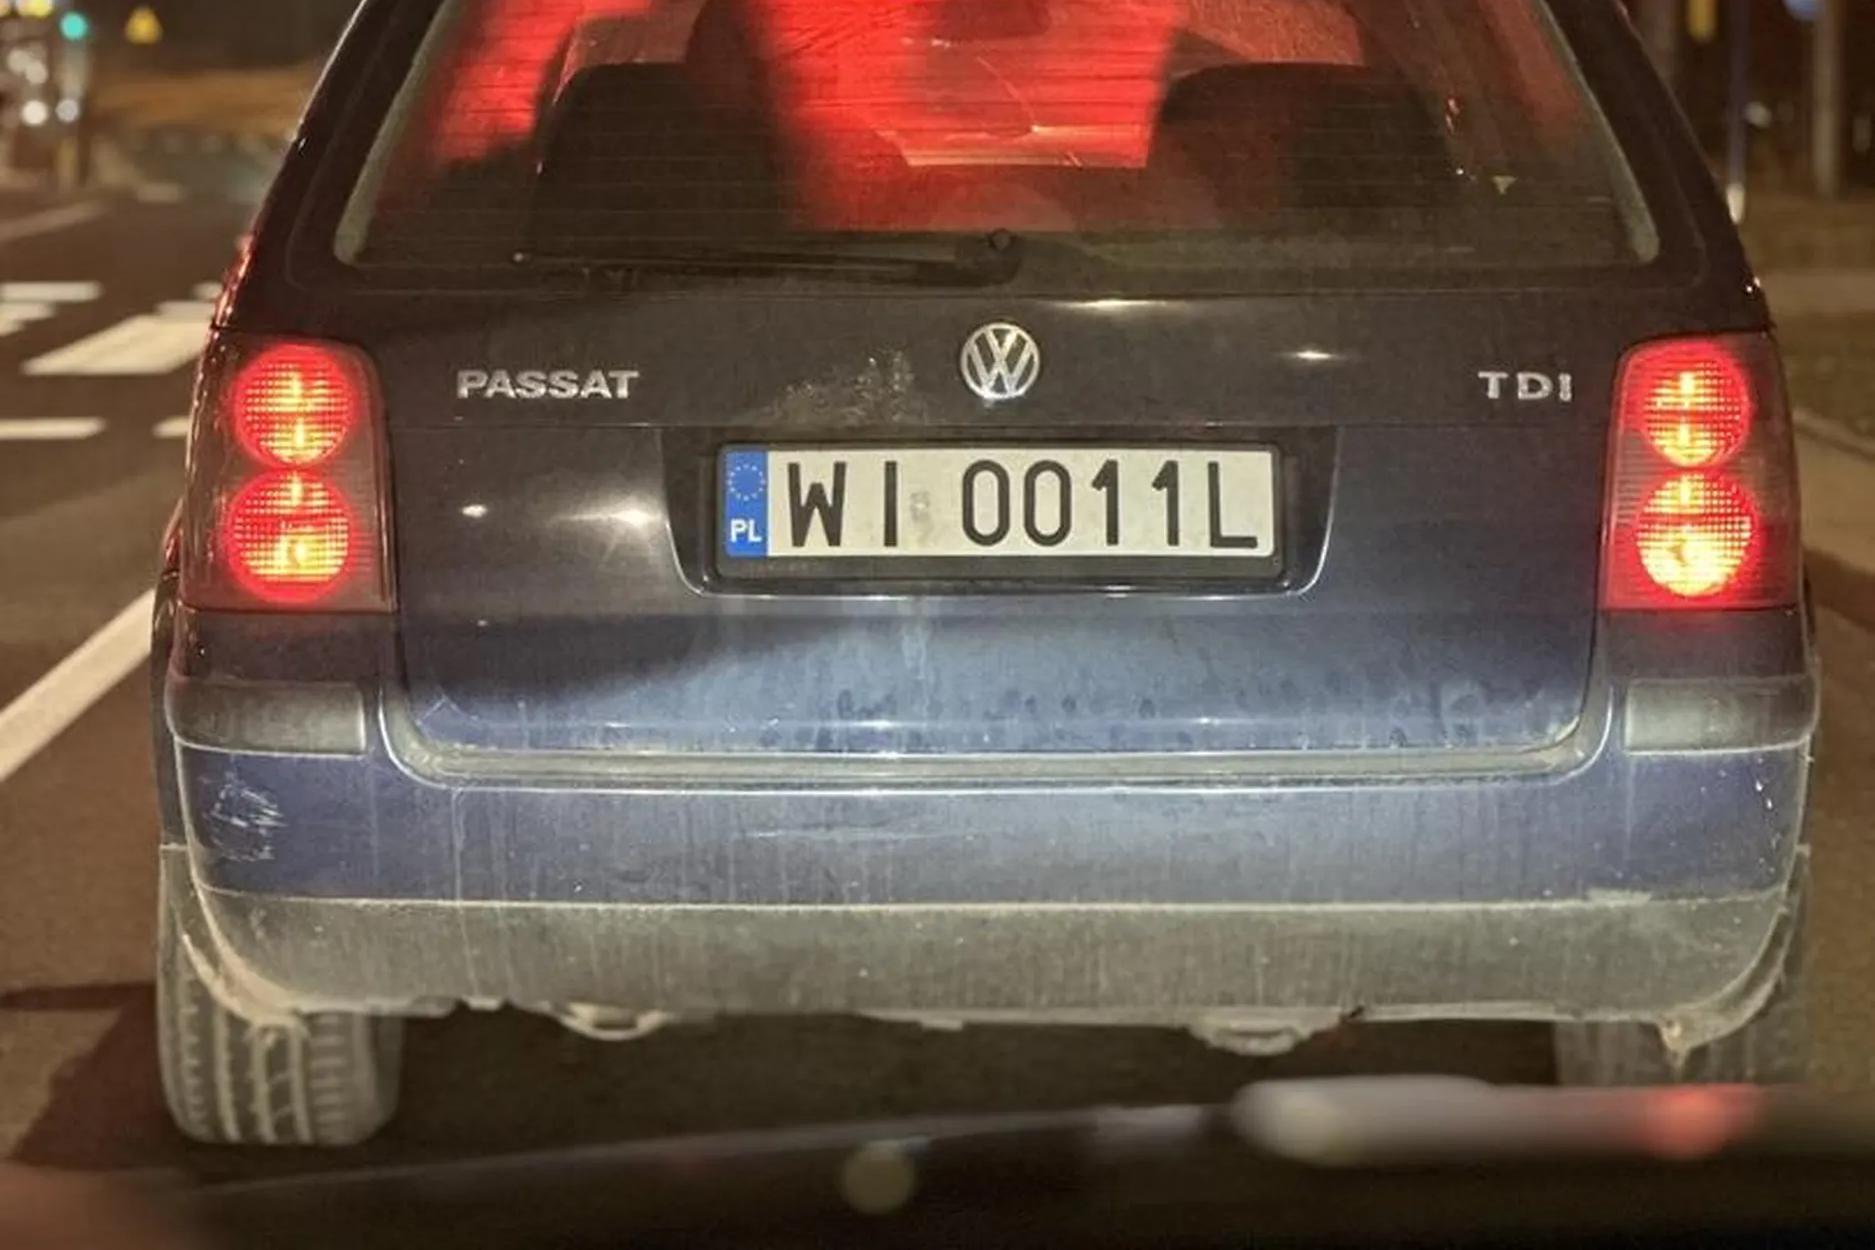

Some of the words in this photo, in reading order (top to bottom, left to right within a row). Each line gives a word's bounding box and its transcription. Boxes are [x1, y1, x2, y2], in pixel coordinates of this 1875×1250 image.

[457, 369, 640, 399] PASSAT
[1477, 371, 1572, 402] TDI
[787, 461, 898, 548] WI
[961, 459, 1258, 549] 0011L
[730, 520, 763, 543] PL
